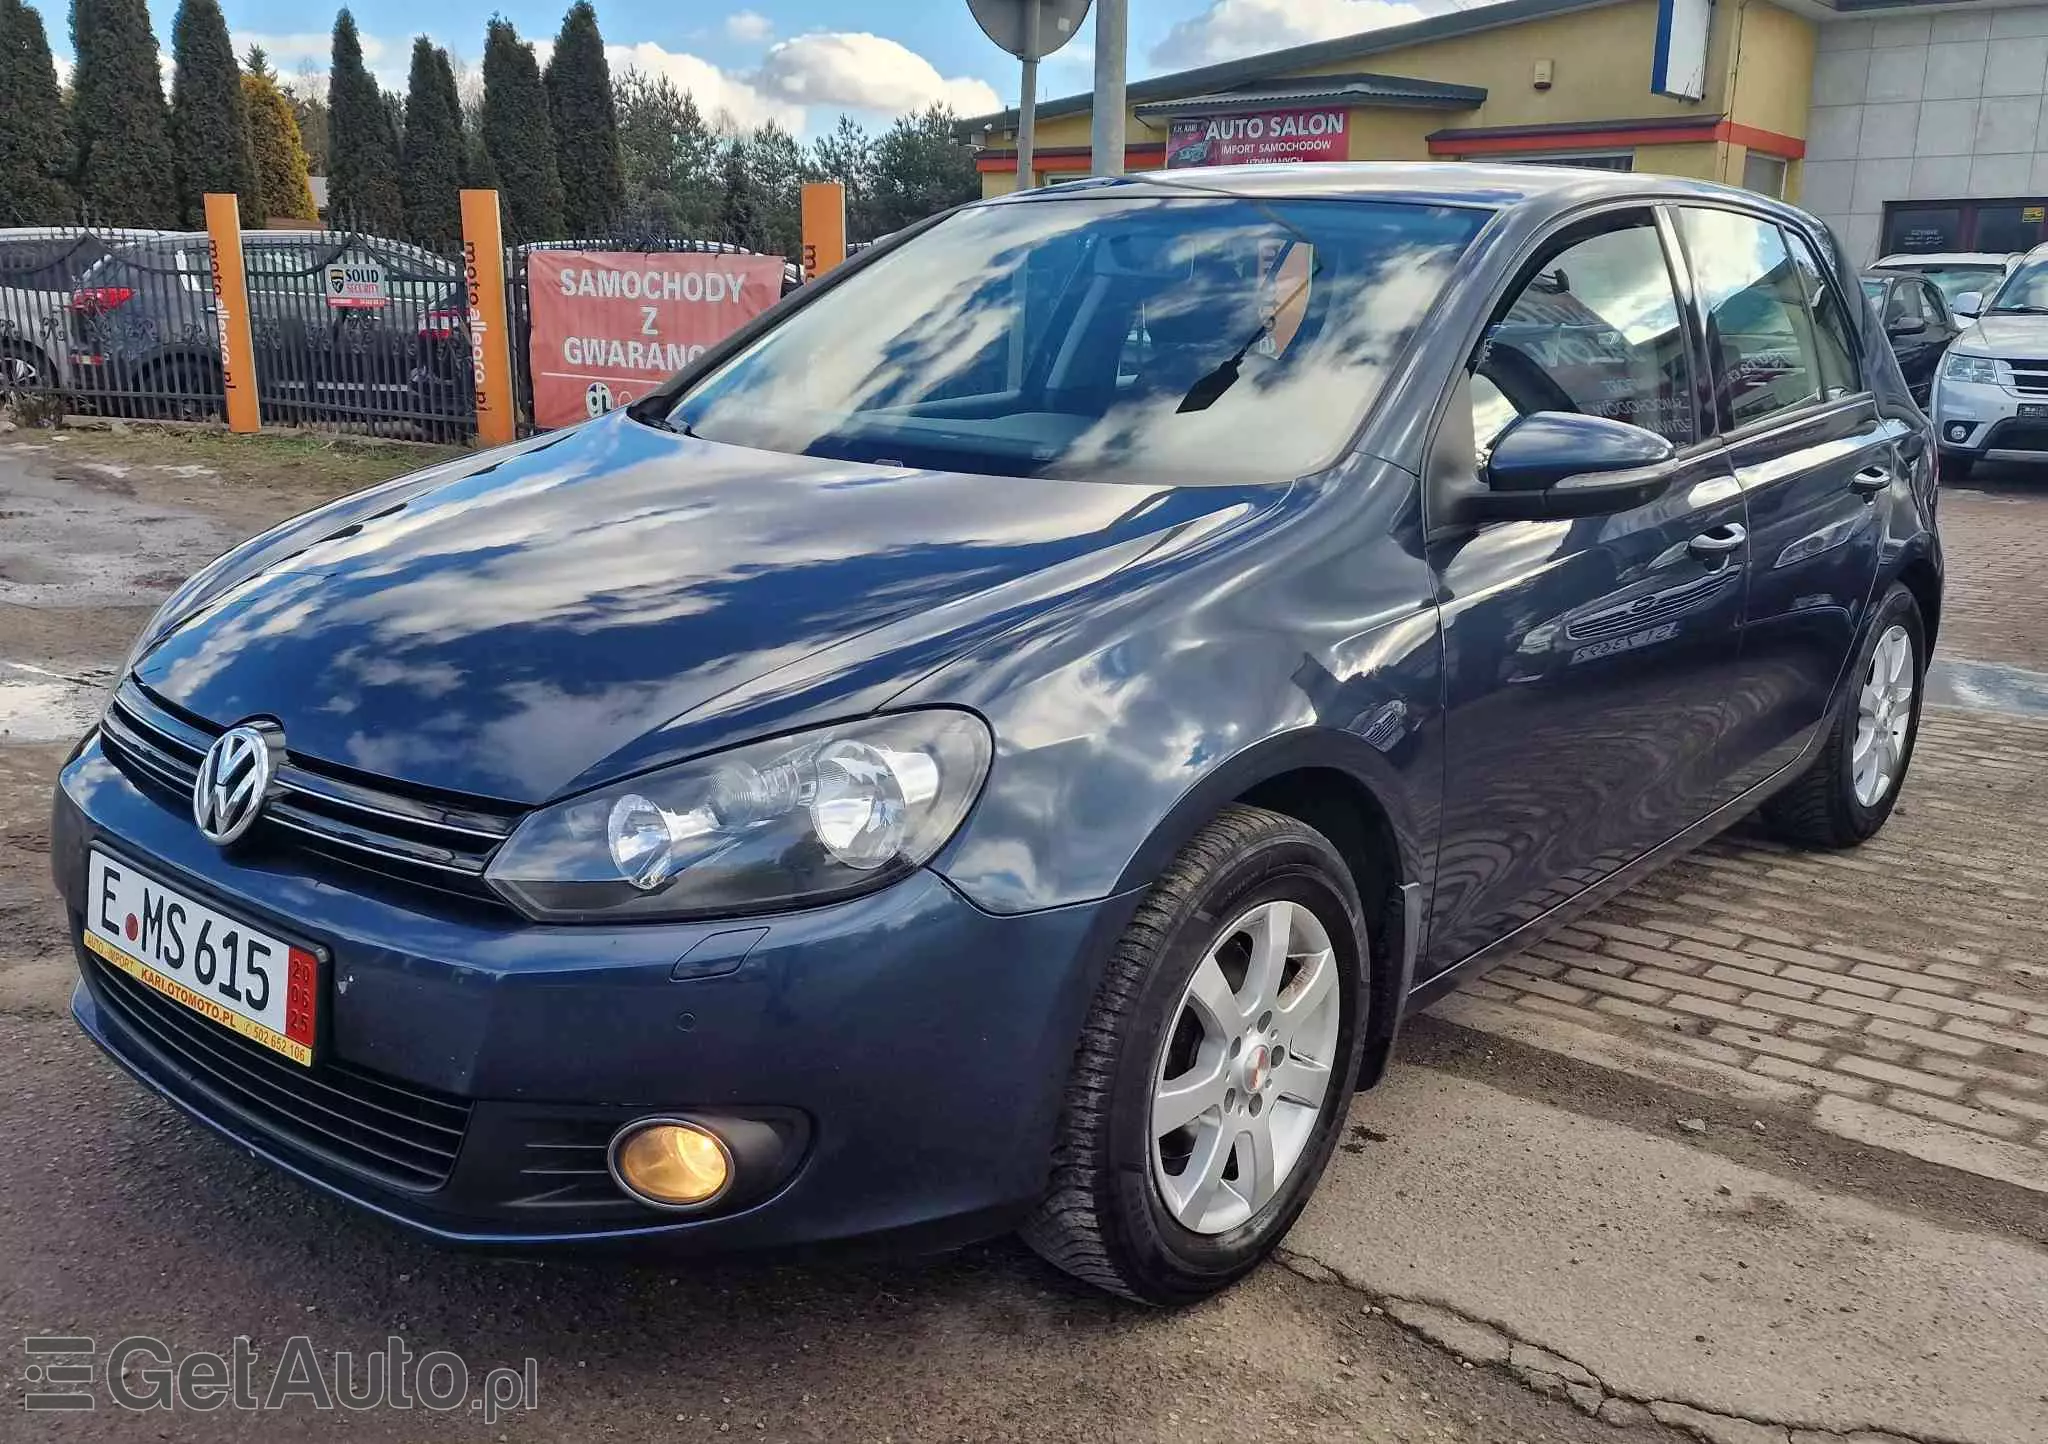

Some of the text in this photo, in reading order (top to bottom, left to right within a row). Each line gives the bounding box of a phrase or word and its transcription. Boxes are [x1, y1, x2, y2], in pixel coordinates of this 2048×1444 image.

[1205, 113, 1343, 140] AUTO SALON
[1221, 143, 1255, 155] IMPORT
[345, 268, 379, 283] SOLID
[559, 268, 746, 303] SAMOCHODY
[640, 305, 659, 335] Z
[101, 866, 121, 936] E
[253, 1026, 269, 1044] 502
[270, 1033, 286, 1052] 652
[290, 1041, 305, 1062] 106
